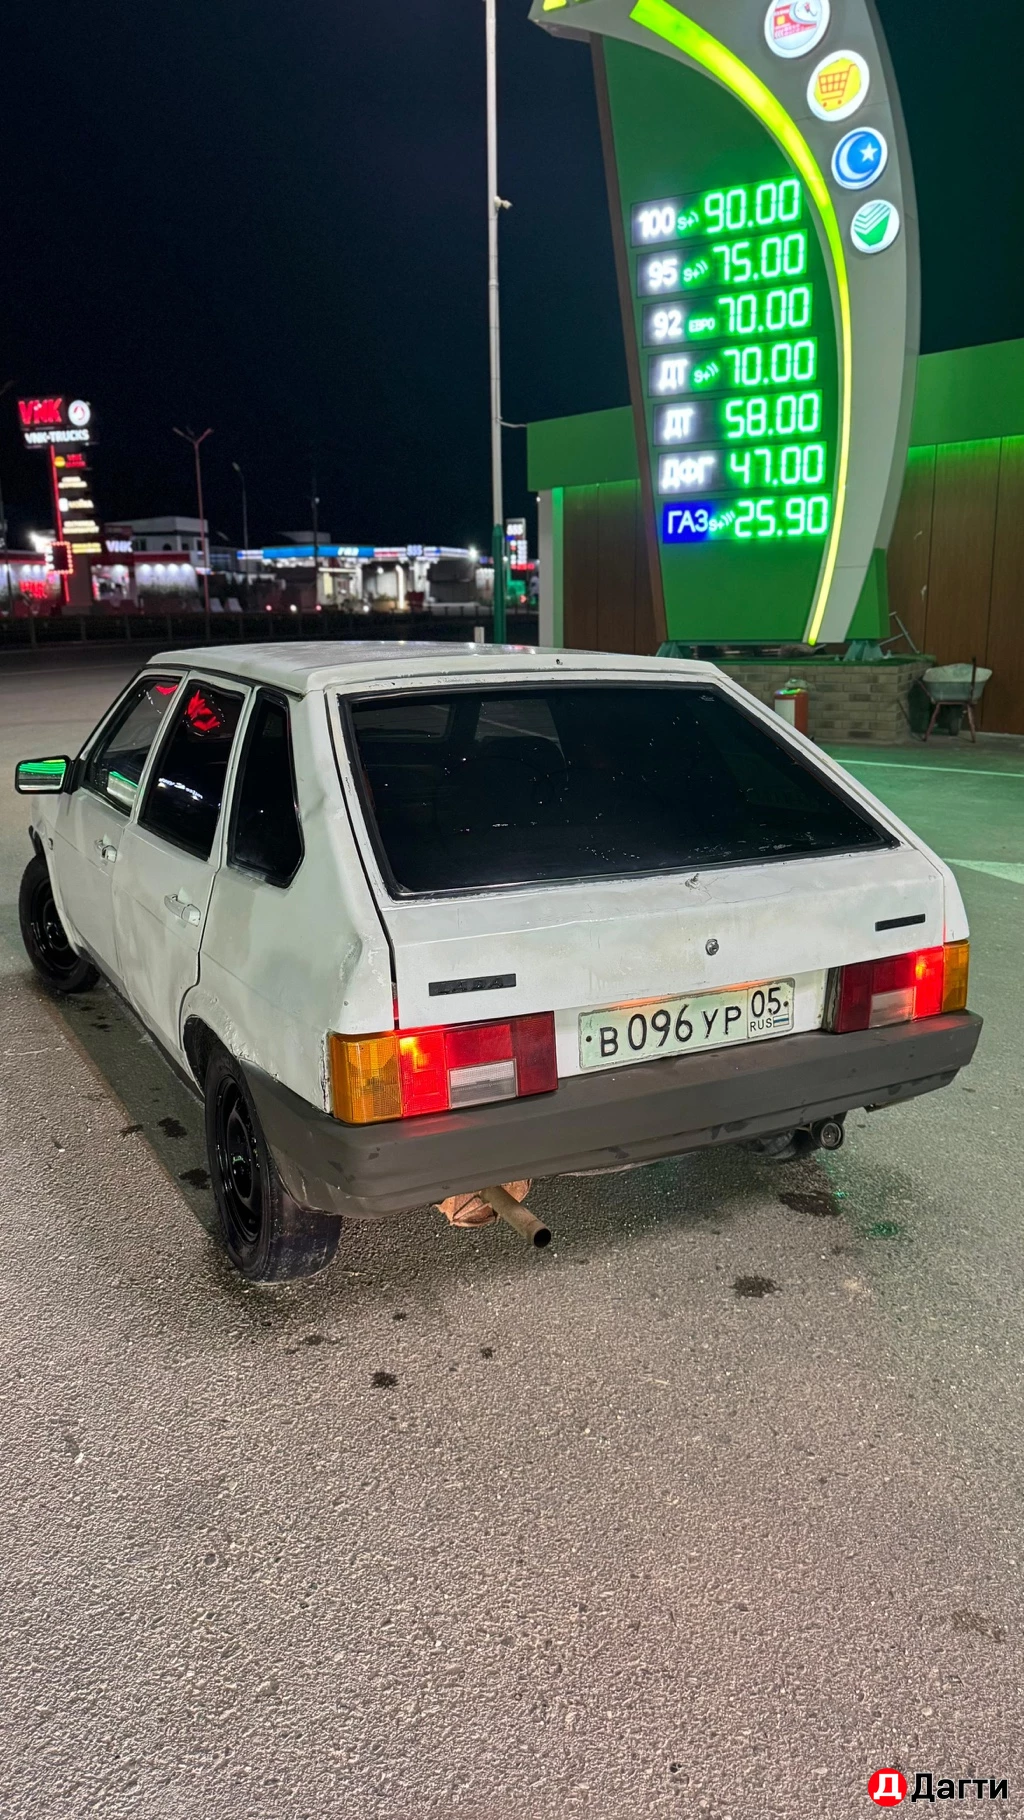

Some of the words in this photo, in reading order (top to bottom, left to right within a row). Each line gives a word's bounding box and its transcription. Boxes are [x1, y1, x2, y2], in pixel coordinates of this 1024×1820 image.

[639, 206, 675, 238] 100
[704, 178, 800, 233] 90.00
[648, 257, 678, 290] 95
[713, 233, 804, 282] 75.00
[653, 309, 682, 339] 92
[718, 287, 809, 334] 70.00
[658, 358, 689, 391] ДТ
[723, 341, 814, 386] 70.00
[663, 407, 694, 440] ДТ
[725, 393, 819, 438] 58.00
[662, 456, 715, 489] ДФГ
[730, 444, 824, 485] 47.00
[667, 509, 709, 534] ГАЗ
[734, 496, 828, 538] 25.90
[750, 1020, 772, 1032] RUS
[751, 987, 781, 1018] 05
